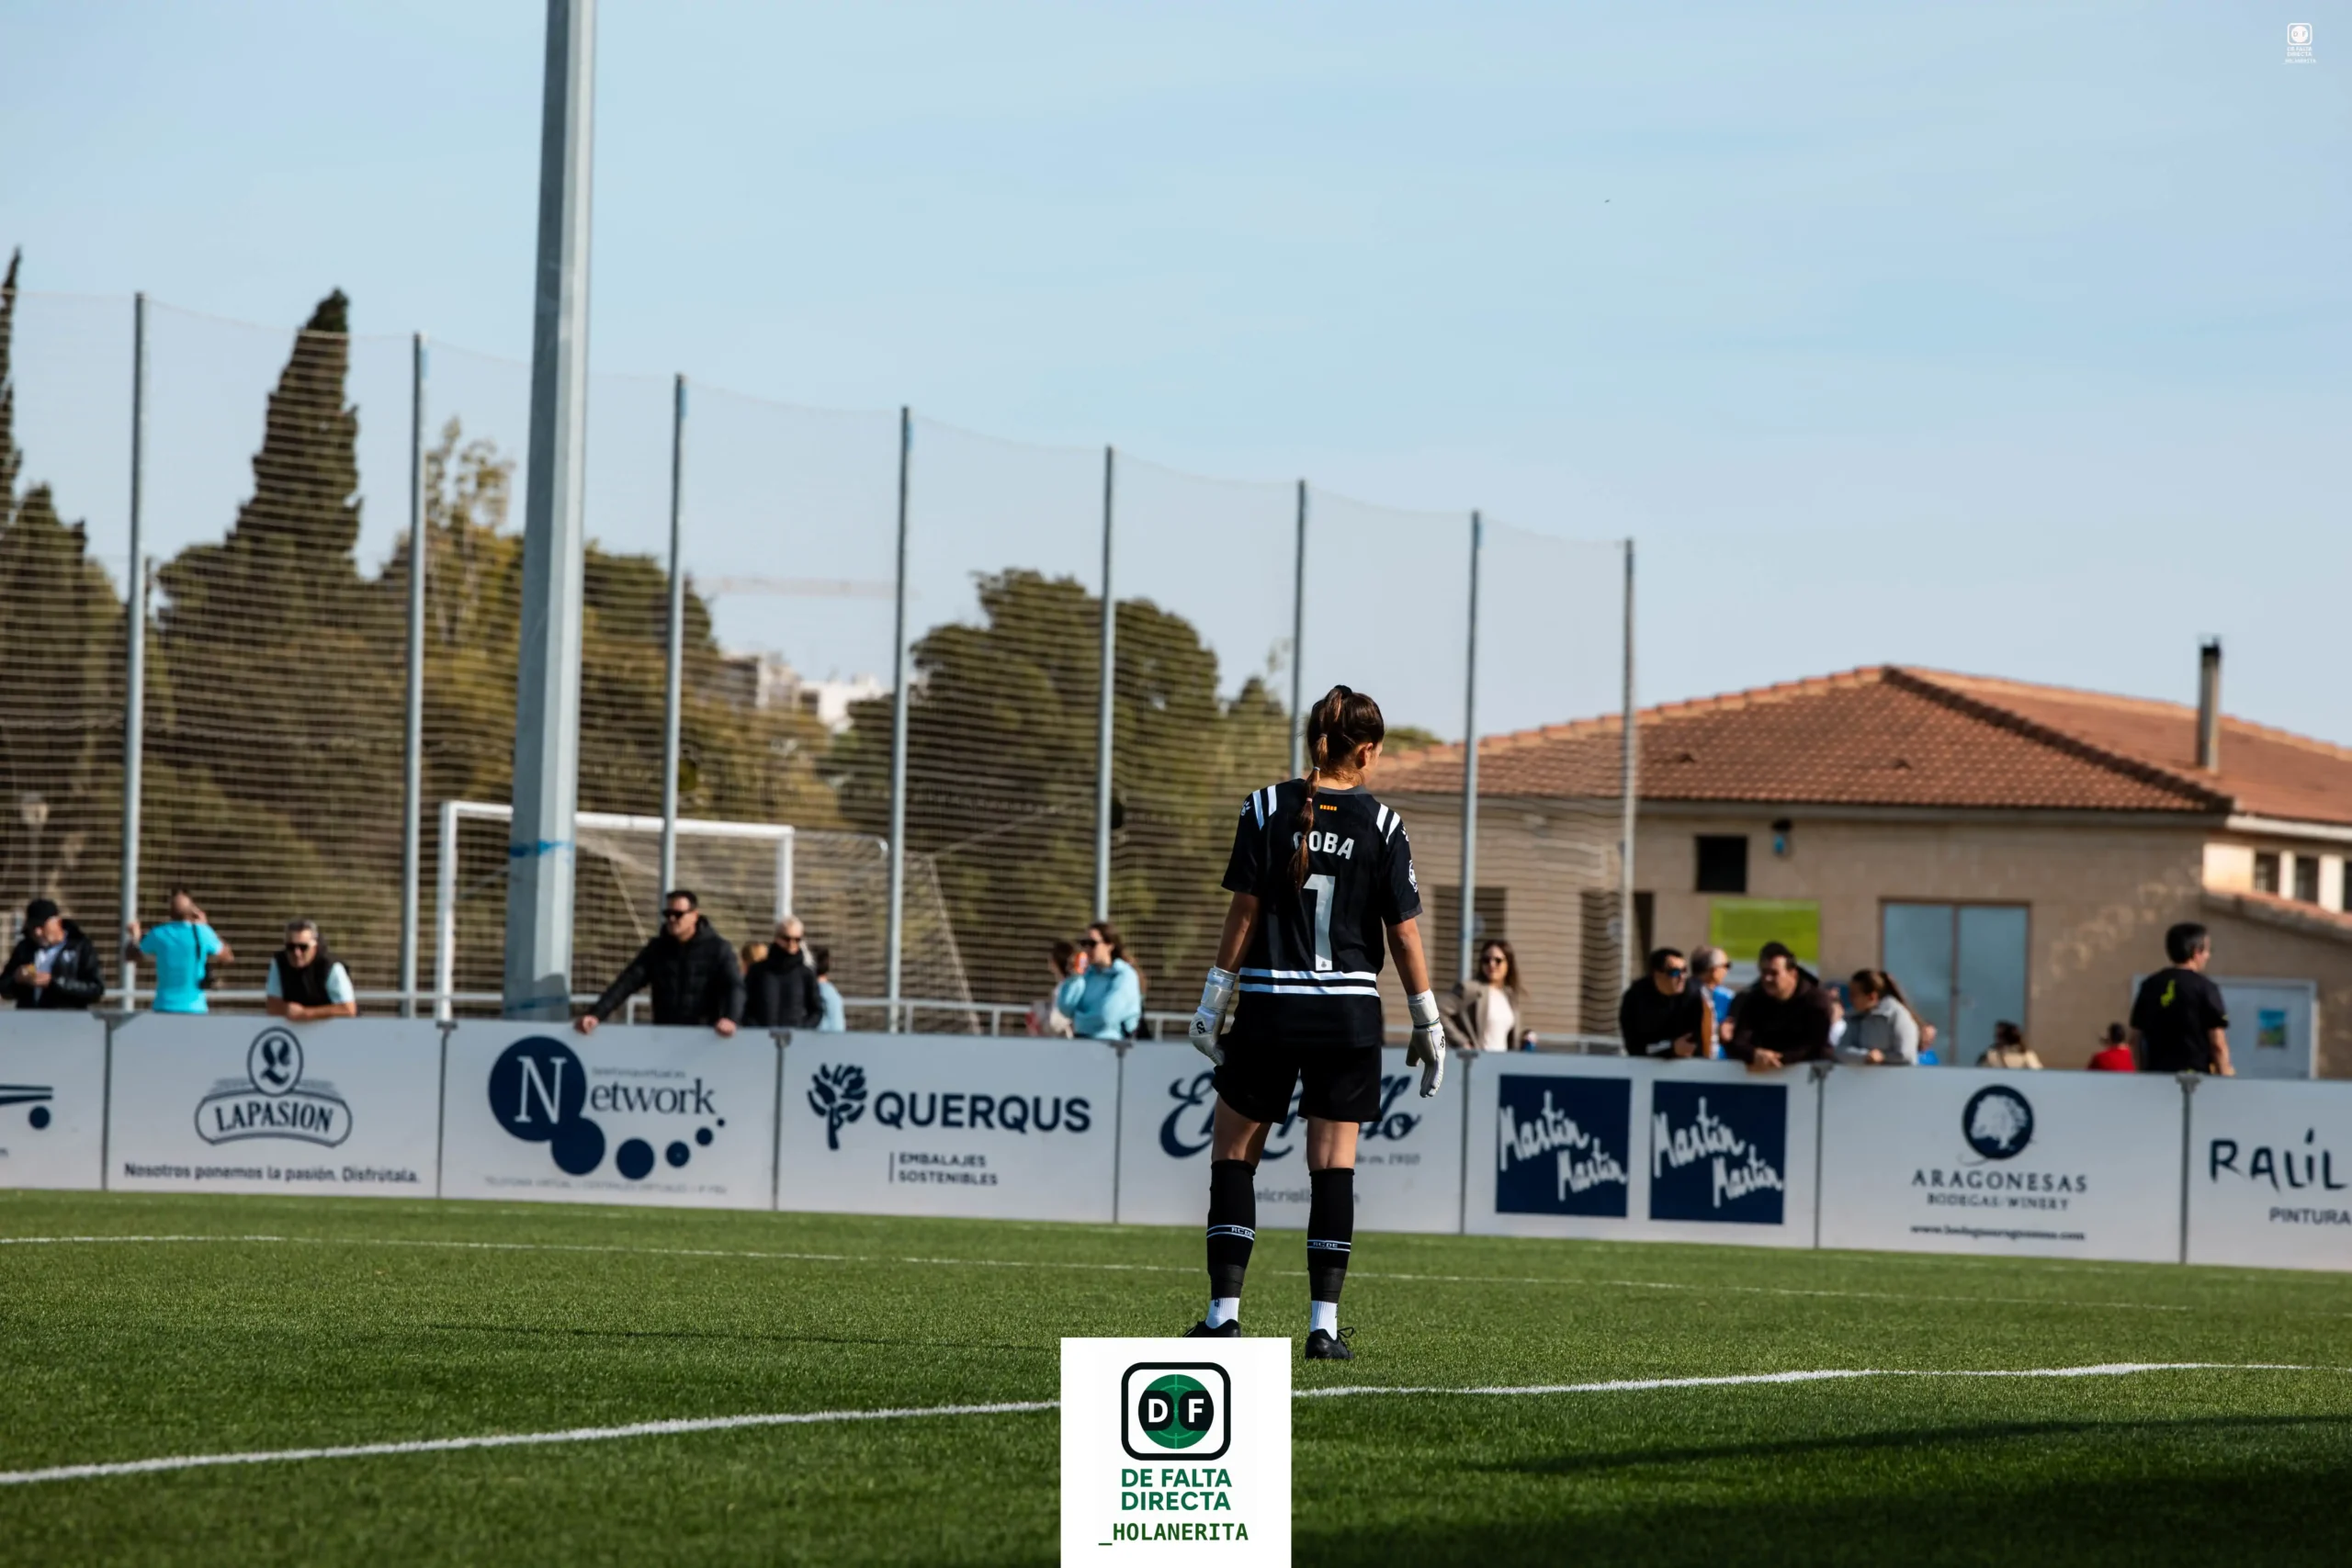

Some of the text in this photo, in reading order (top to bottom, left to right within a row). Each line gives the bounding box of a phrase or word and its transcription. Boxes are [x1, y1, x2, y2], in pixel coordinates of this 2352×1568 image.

[1304, 874, 1336, 971] 1
[214, 1100, 334, 1134] LAPASION
[874, 1090, 1091, 1134] QUERQUS
[124, 1162, 190, 1179] Nosotros
[195, 1165, 263, 1181] ponemos
[267, 1165, 281, 1180] la
[899, 1152, 987, 1168] EMBALAJES
[899, 1170, 999, 1187] SOSTENIBLES
[1912, 1168, 2088, 1193] ARAGONESAS
